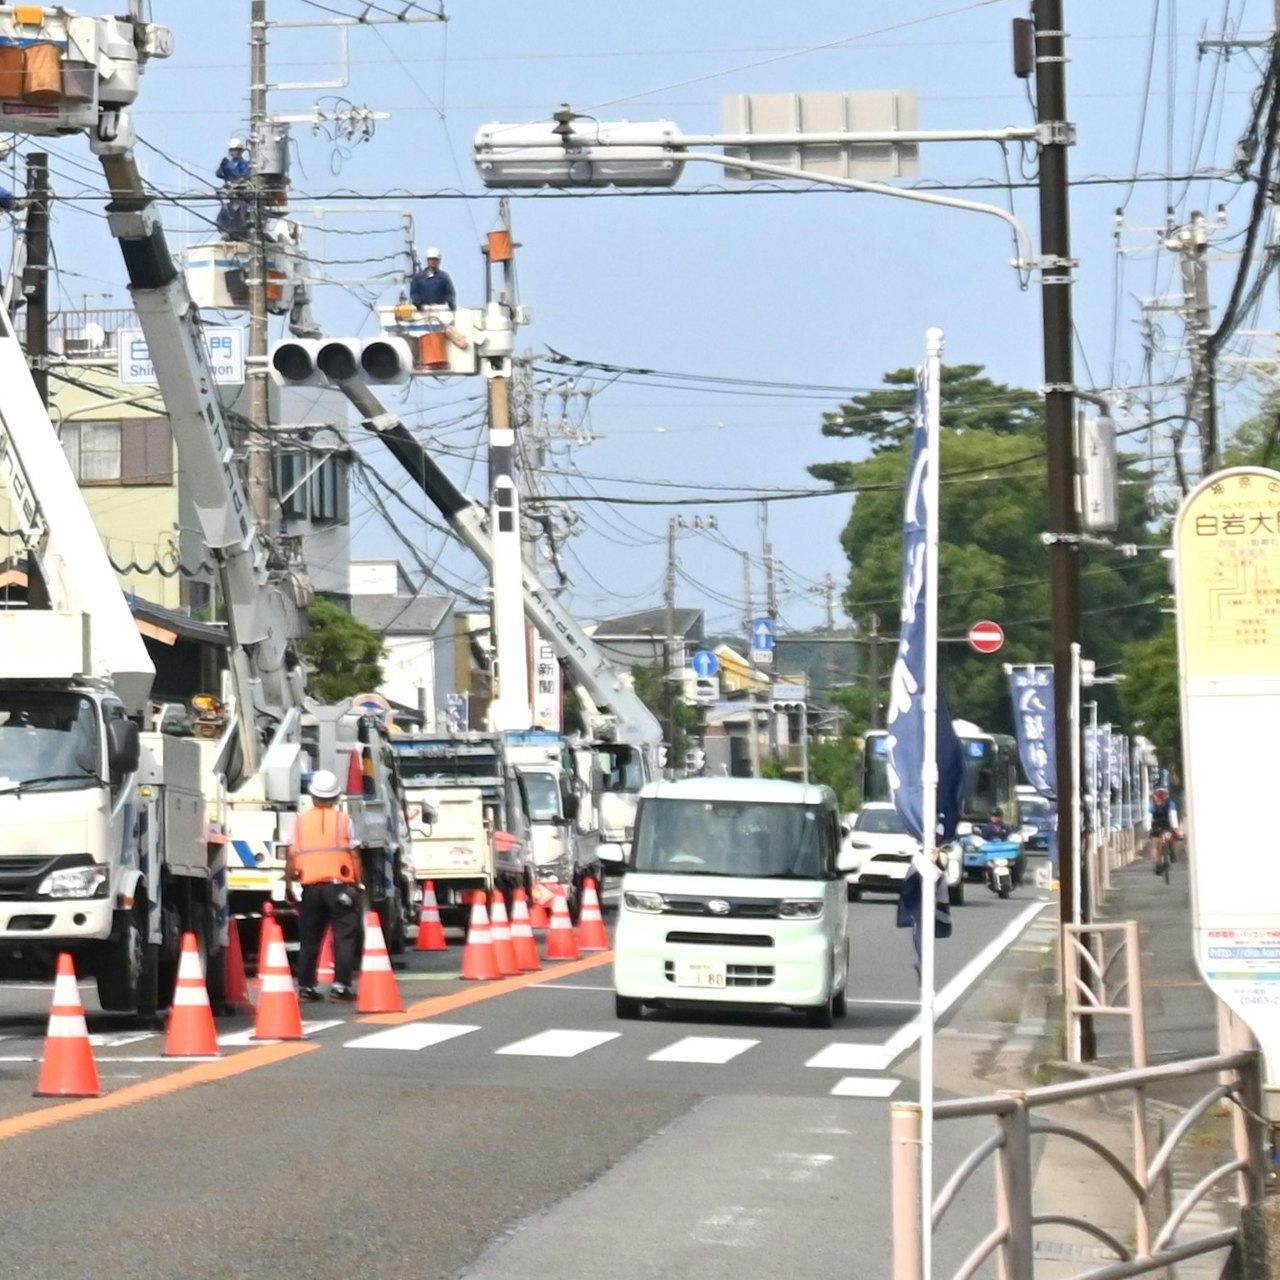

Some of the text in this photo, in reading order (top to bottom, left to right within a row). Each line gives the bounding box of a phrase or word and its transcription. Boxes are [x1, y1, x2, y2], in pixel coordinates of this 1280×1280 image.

[130, 337, 233, 361] 白門
[1195, 511, 1280, 537] 白岩大
